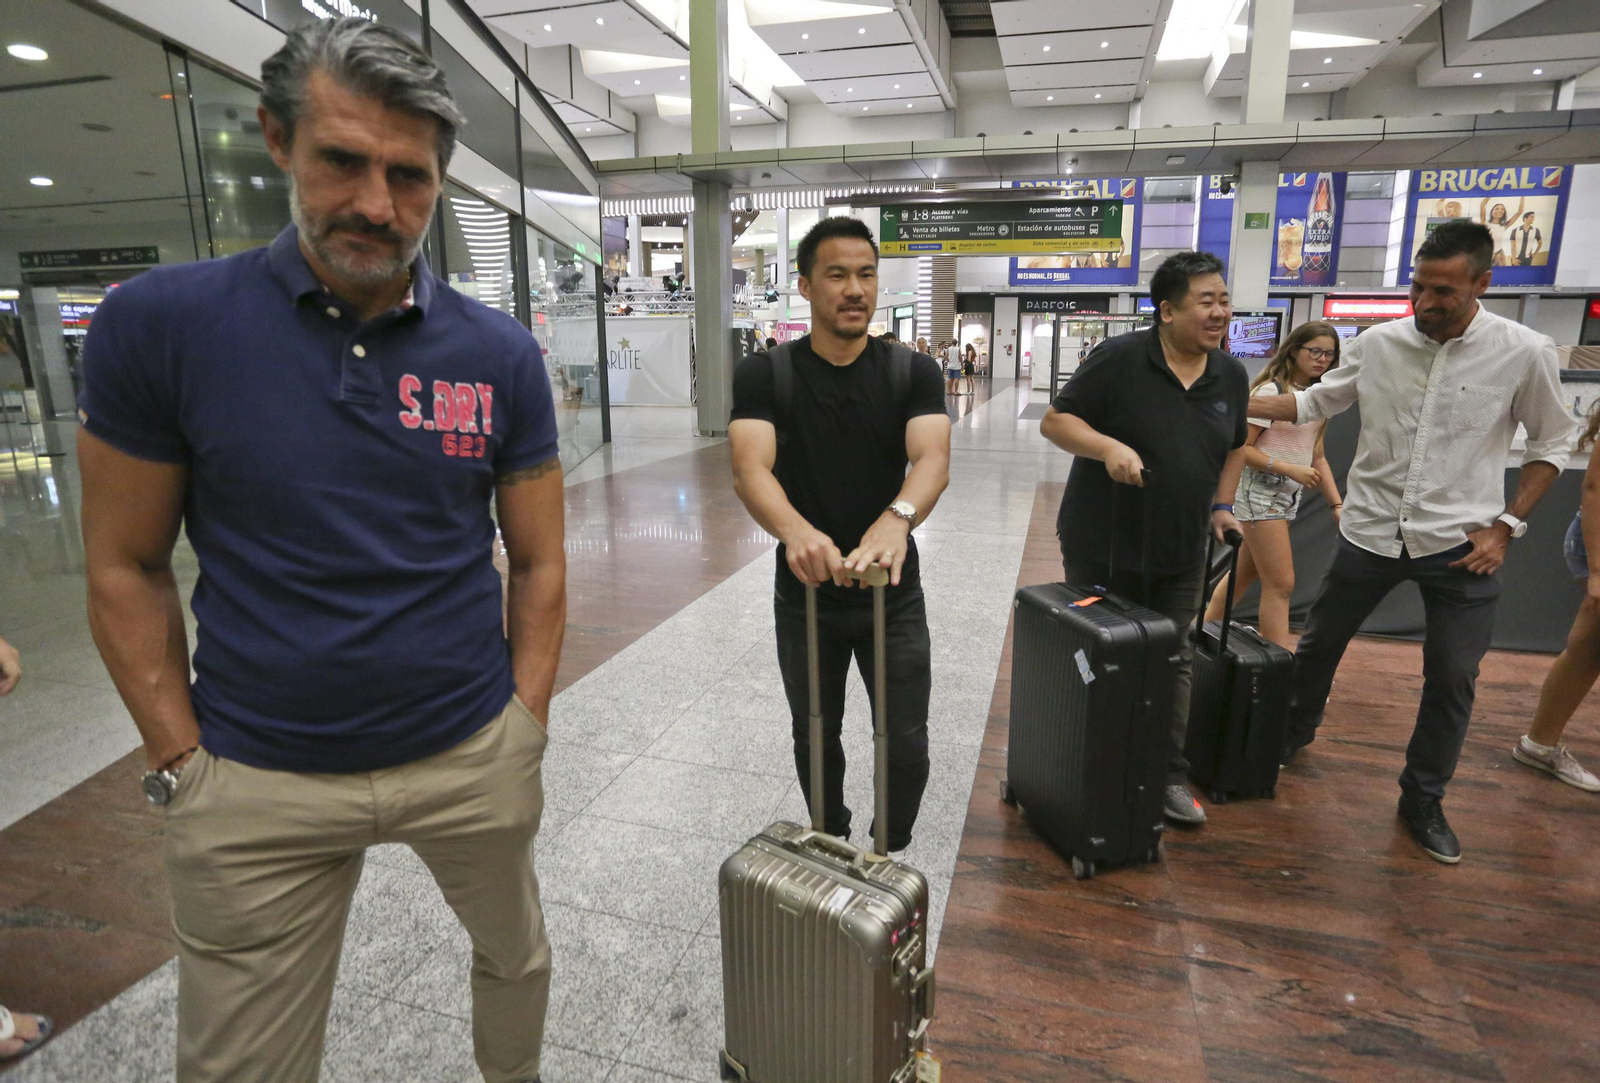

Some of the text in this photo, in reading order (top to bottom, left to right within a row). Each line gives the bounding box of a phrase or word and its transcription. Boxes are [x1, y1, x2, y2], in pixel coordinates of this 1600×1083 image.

[1418, 167, 1537, 192] BRUGAL
[912, 208, 929, 221] 1-8
[956, 207, 969, 215] vías
[1028, 206, 1072, 215] Aparcamiento
[1091, 206, 1099, 217] P
[938, 225, 960, 233] billetes
[1017, 224, 1043, 232] Estación
[899, 244, 906, 252] H
[1026, 301, 1077, 310] PARFOIS
[398, 373, 494, 435] S.DRY
